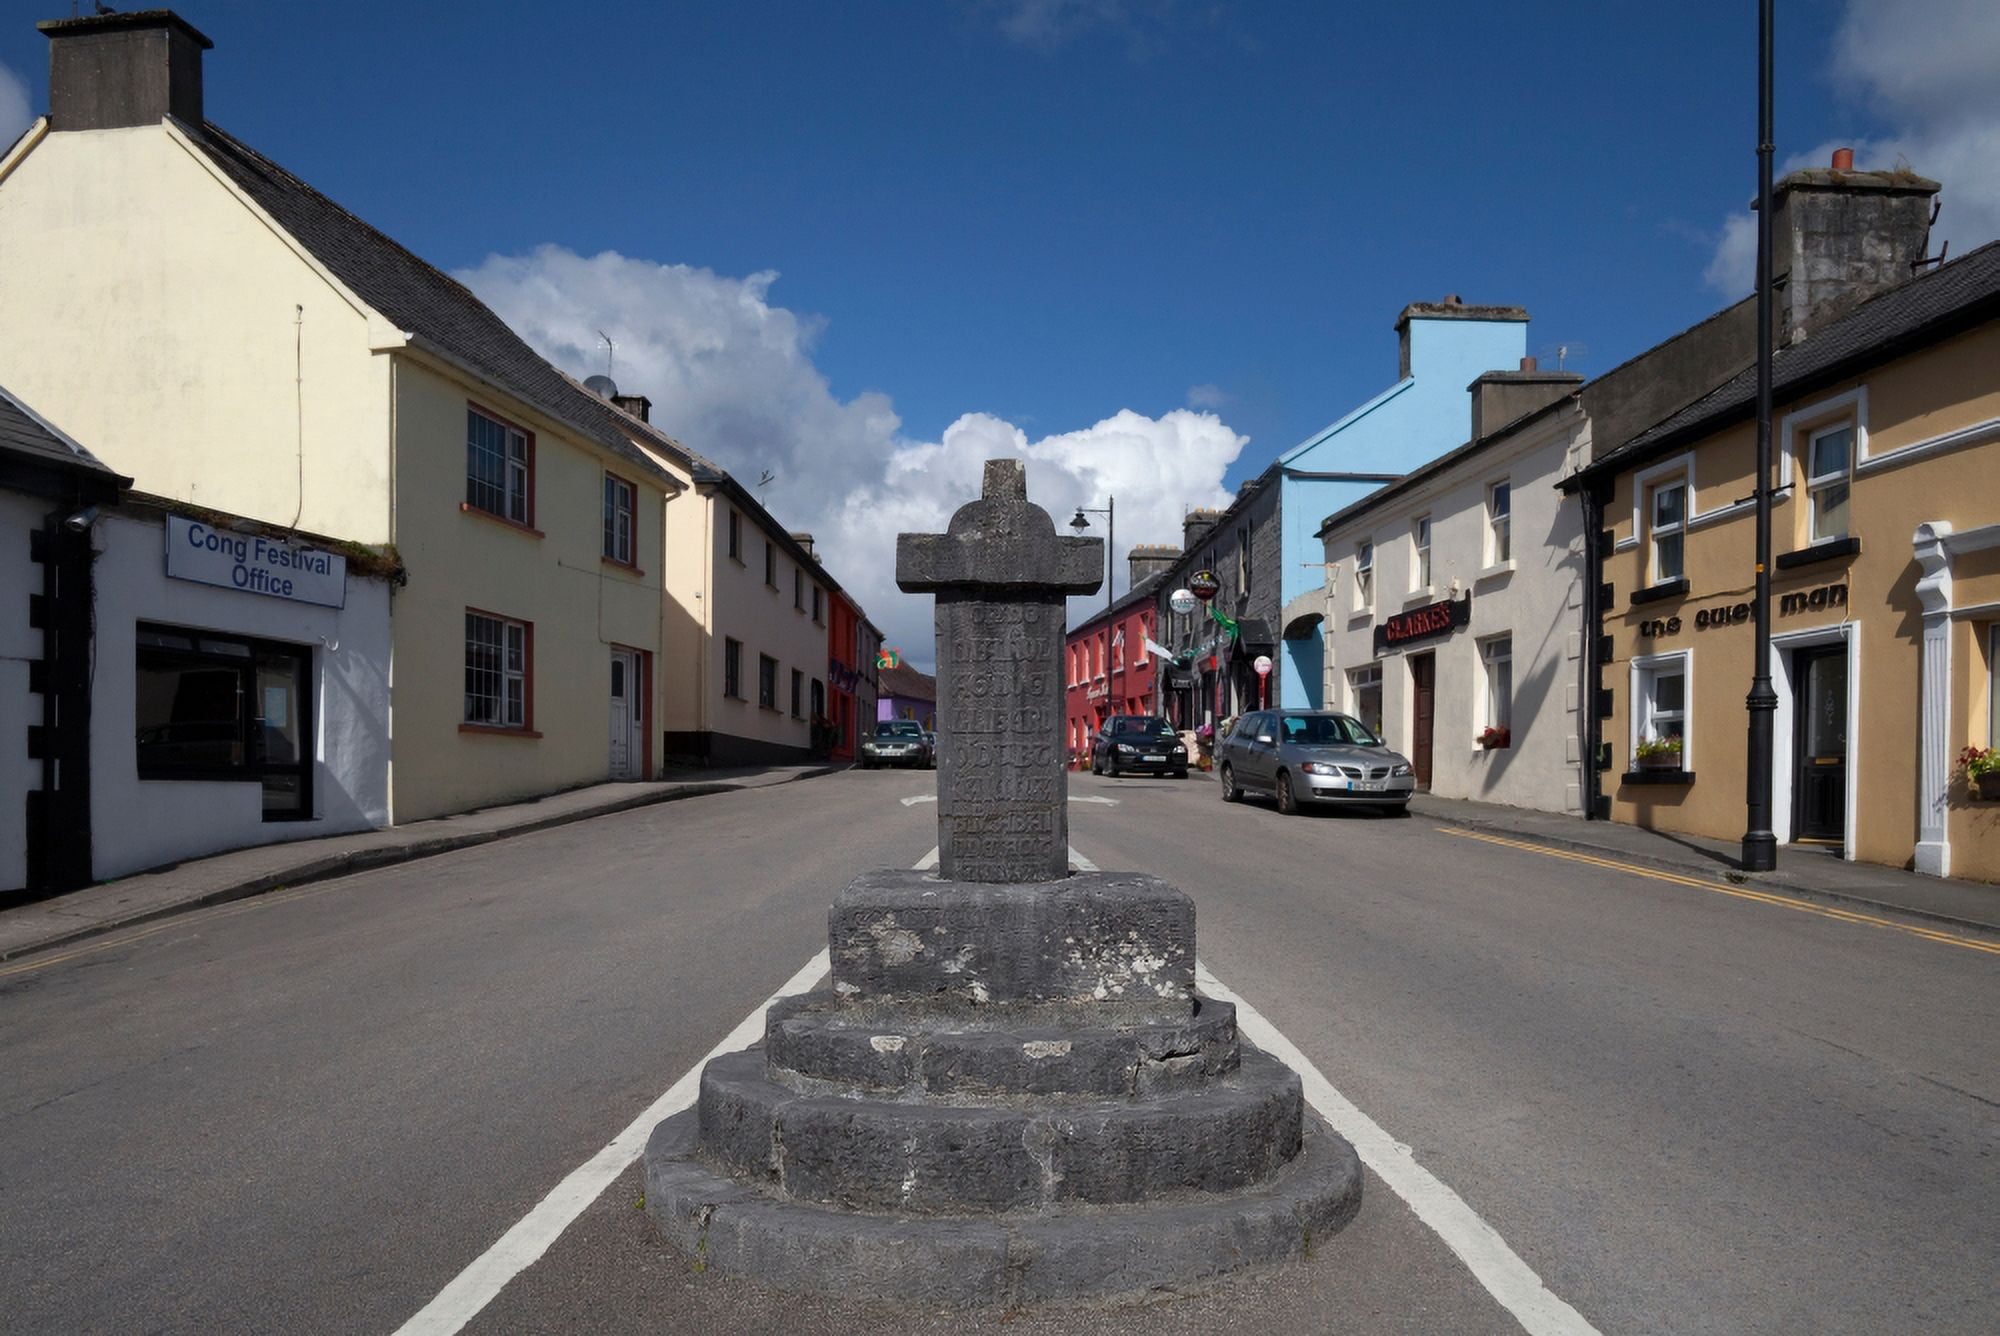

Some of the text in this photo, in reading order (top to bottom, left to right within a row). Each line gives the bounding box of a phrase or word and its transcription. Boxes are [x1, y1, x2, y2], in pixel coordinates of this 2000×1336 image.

[188, 523, 331, 576] Cong Festival
[232, 564, 293, 596] Office
[1640, 615, 1682, 638] the
[1780, 584, 1848, 613] man
